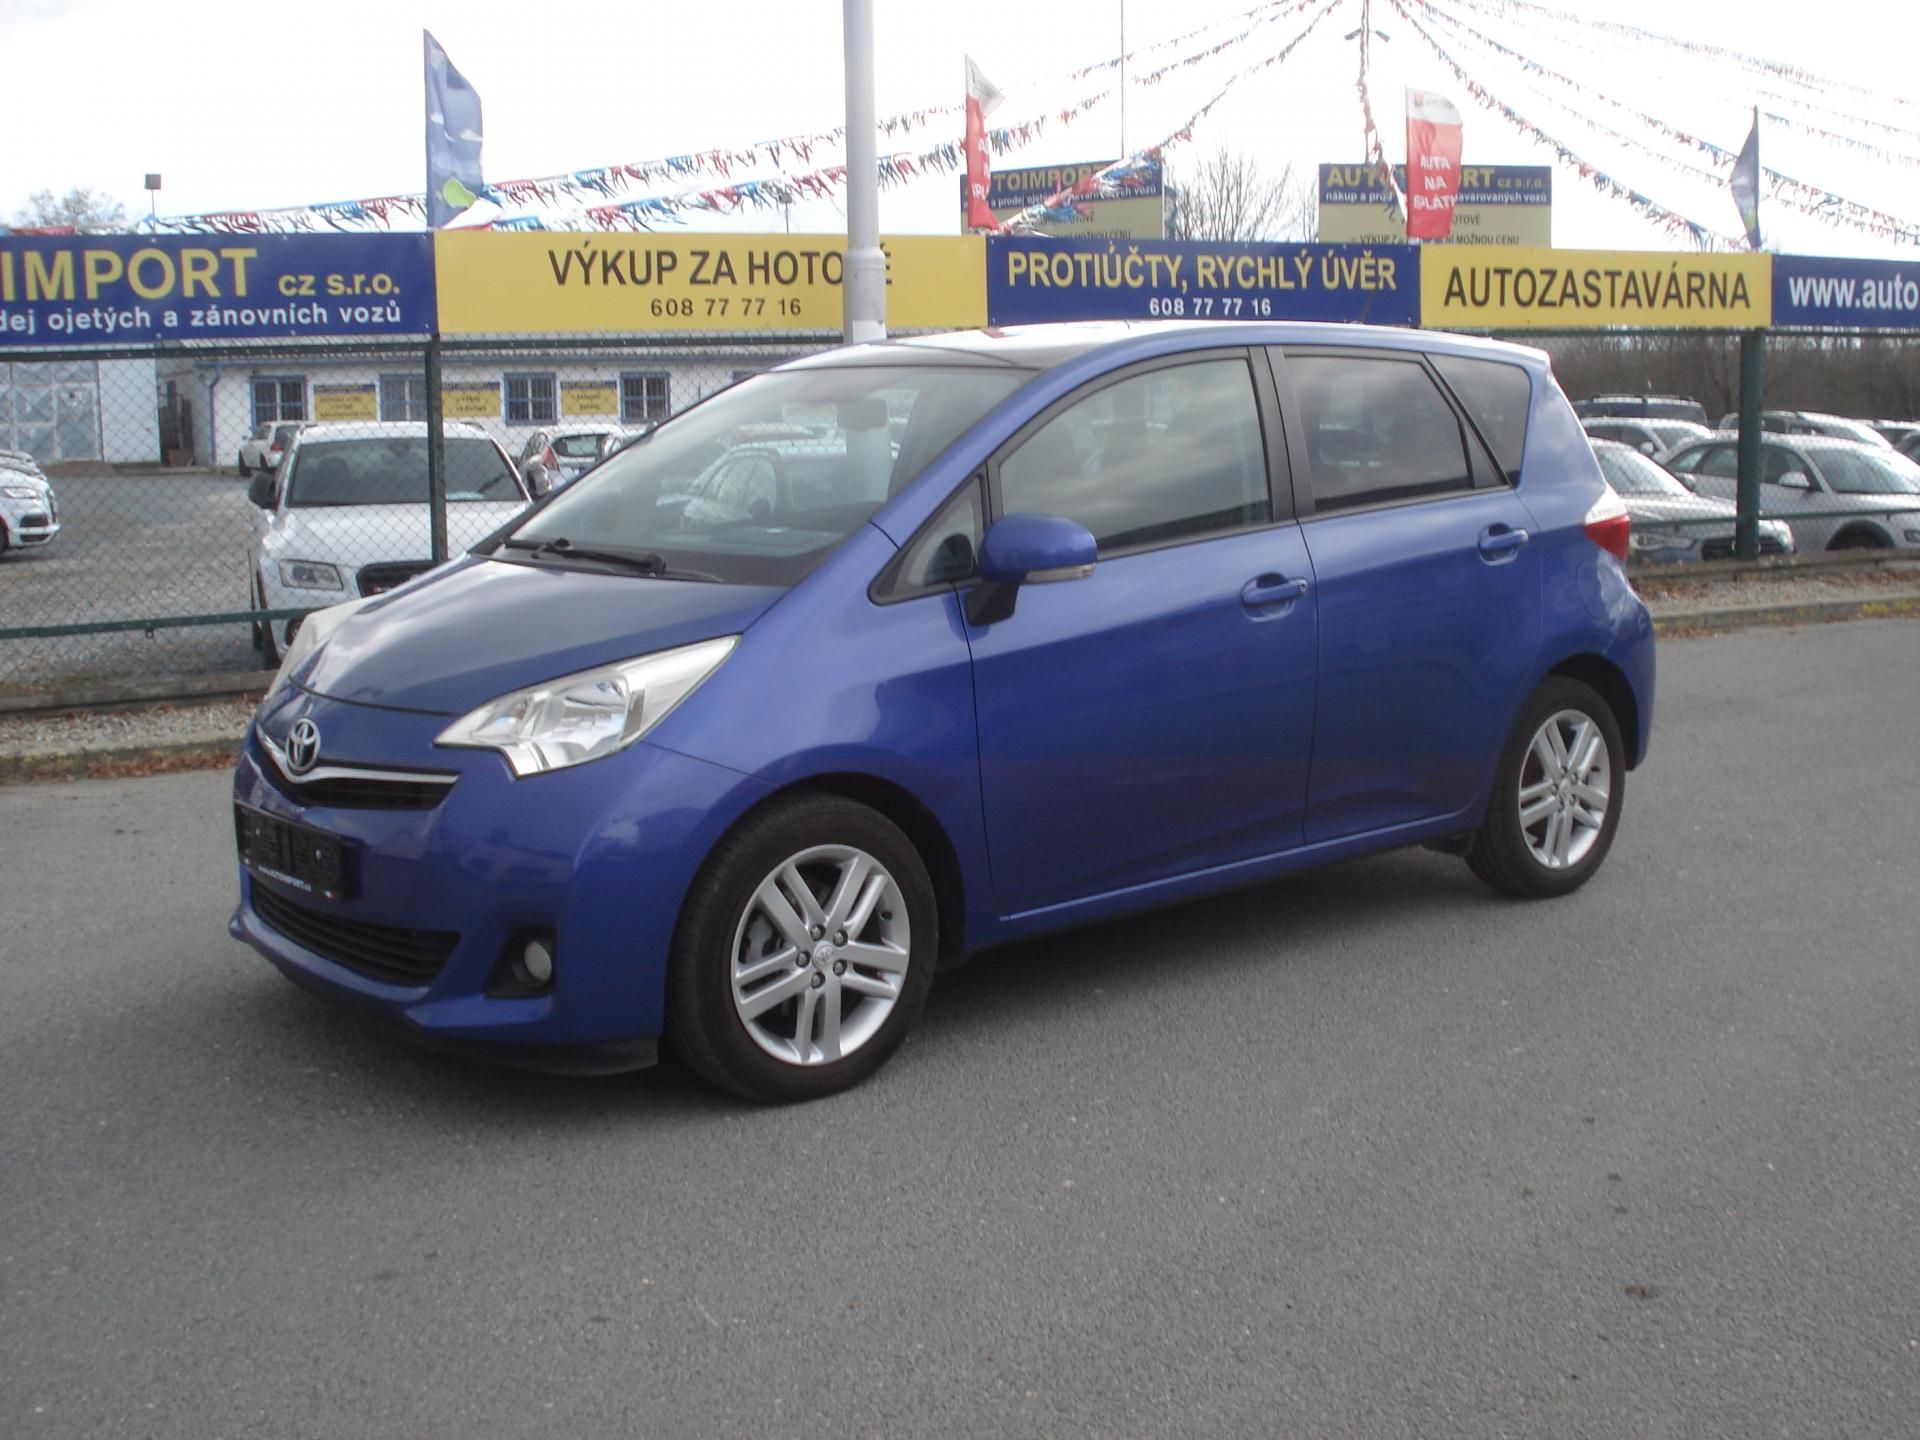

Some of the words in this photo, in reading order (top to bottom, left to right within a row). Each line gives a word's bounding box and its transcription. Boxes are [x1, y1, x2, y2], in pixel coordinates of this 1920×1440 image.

[1326, 190, 1357, 203] nákup
[1360, 193, 1367, 202] a
[1523, 192, 1547, 203] vozů
[1424, 175, 1447, 190] NA
[1496, 234, 1519, 245] CENU
[0, 247, 258, 302] IMPORT
[278, 274, 316, 297] cz
[327, 272, 401, 297] s.r.o.
[548, 240, 679, 286] VÝKUP
[689, 250, 738, 286] ZA
[747, 243, 893, 286] HOTO
[1007, 246, 1188, 294] PROTIÚČTY,
[1197, 249, 1313, 289] RYCHLÝ
[1322, 249, 1397, 290] ÚVĚR
[1443, 261, 1751, 308] AUTOZASTAVÁRNA
[1788, 272, 1920, 310] www.auto
[48, 304, 151, 334] ojetých
[163, 308, 178, 327] a
[190, 302, 328, 327] zánovních
[339, 299, 402, 324] vozů
[651, 298, 694, 318] 608
[704, 298, 730, 317] 77
[741, 298, 767, 317] 77
[778, 298, 802, 317] 16
[1149, 298, 1185, 316] 608
[1192, 298, 1214, 316] 77
[1222, 298, 1243, 316] 77
[1251, 298, 1272, 316] 16
